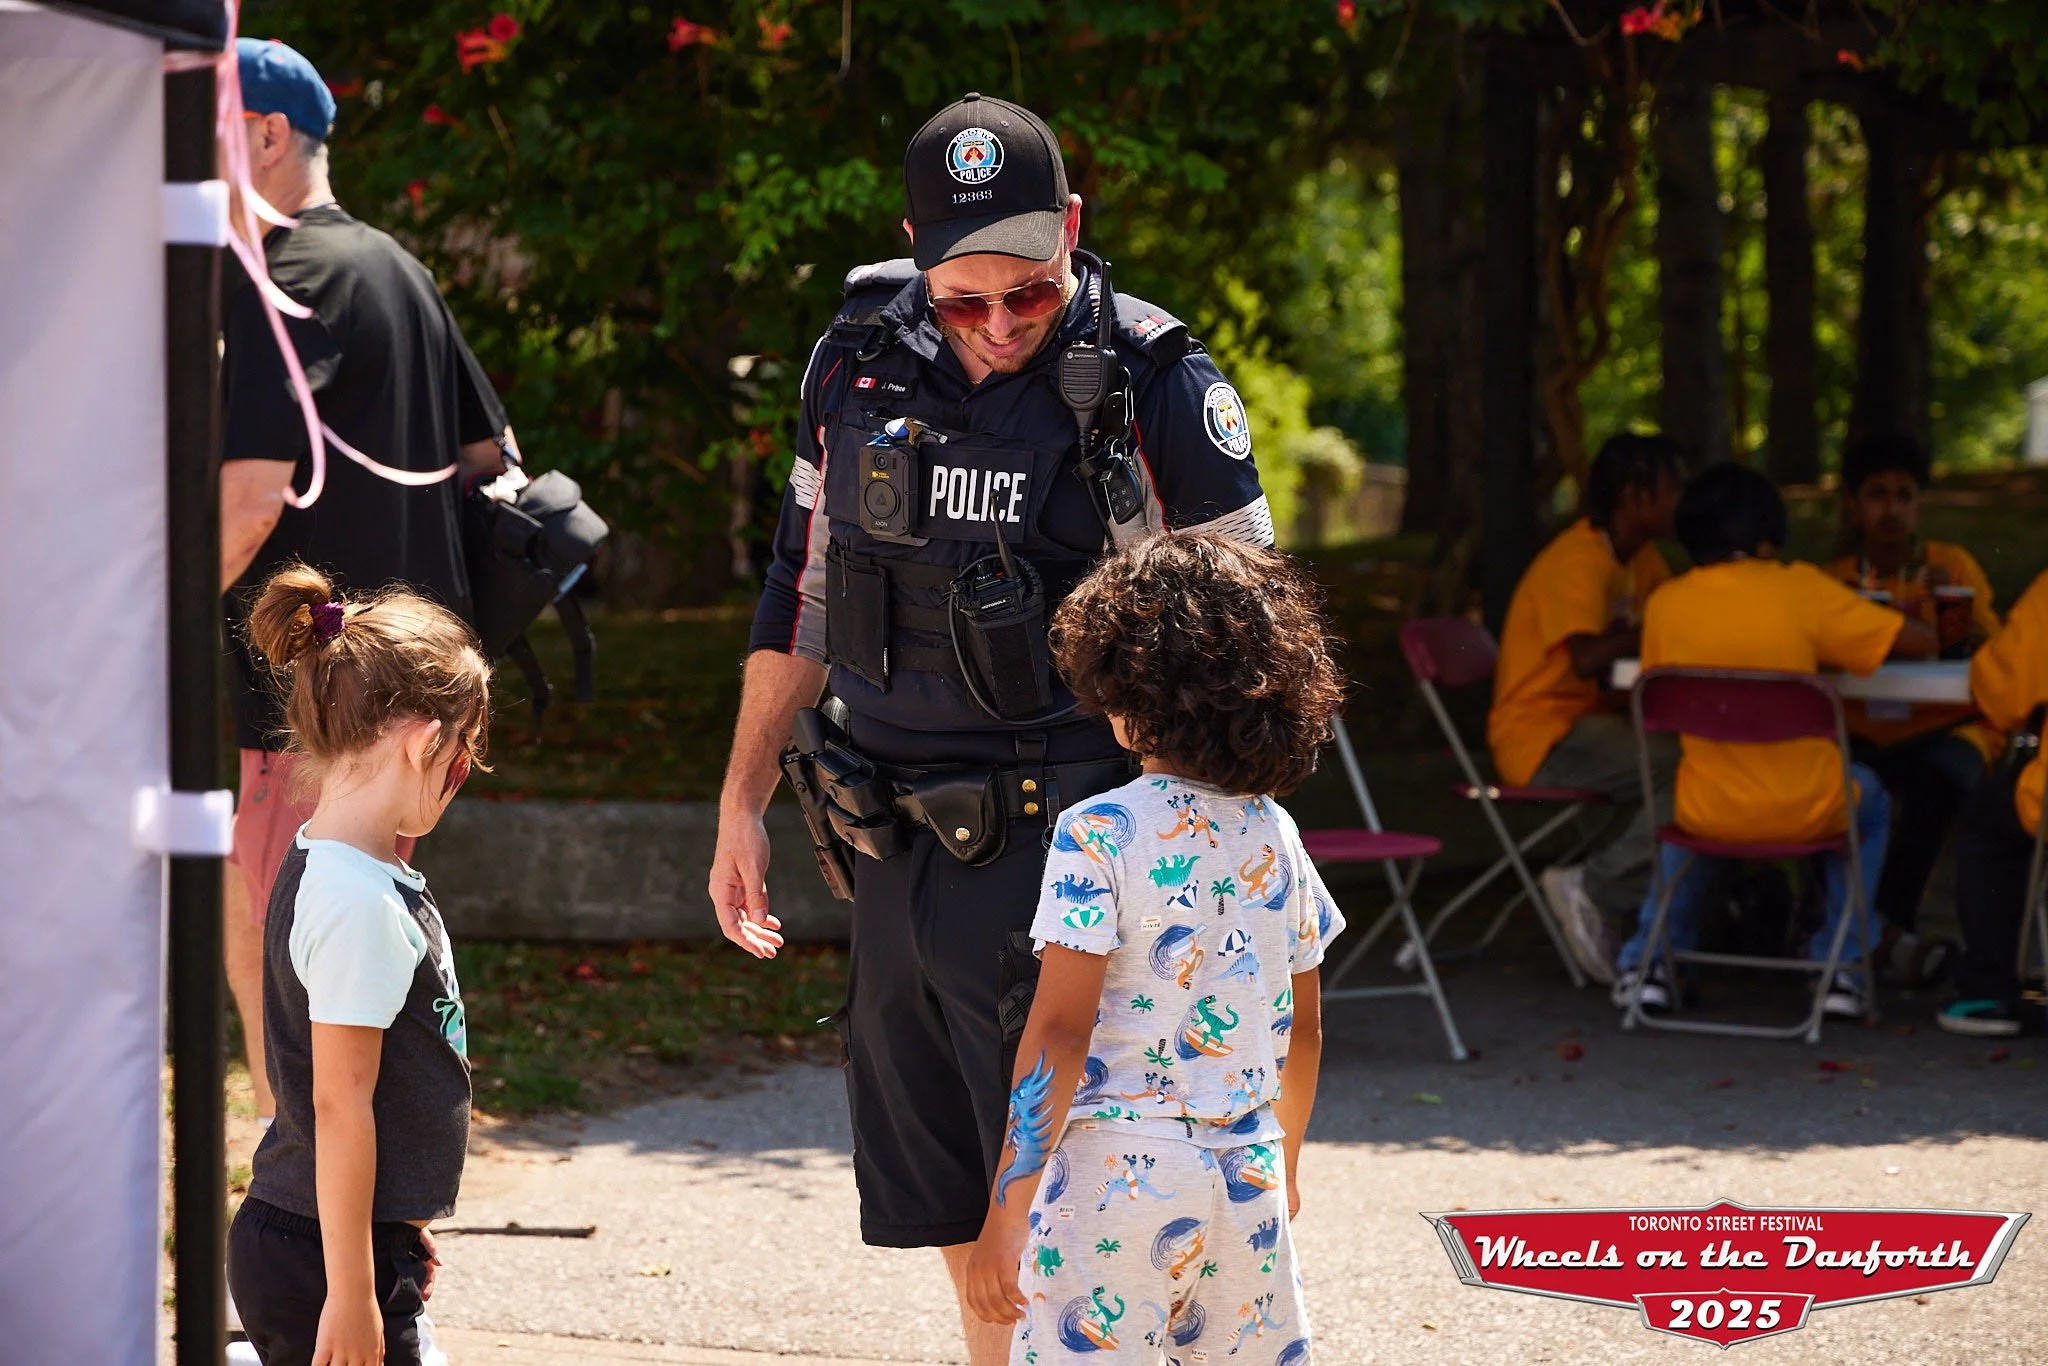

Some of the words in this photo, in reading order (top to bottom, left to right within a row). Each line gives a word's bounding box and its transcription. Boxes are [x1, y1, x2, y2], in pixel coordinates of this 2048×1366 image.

[960, 167, 992, 181] POLICE
[952, 189, 993, 204] 12363
[929, 465, 1027, 523] POLICE
